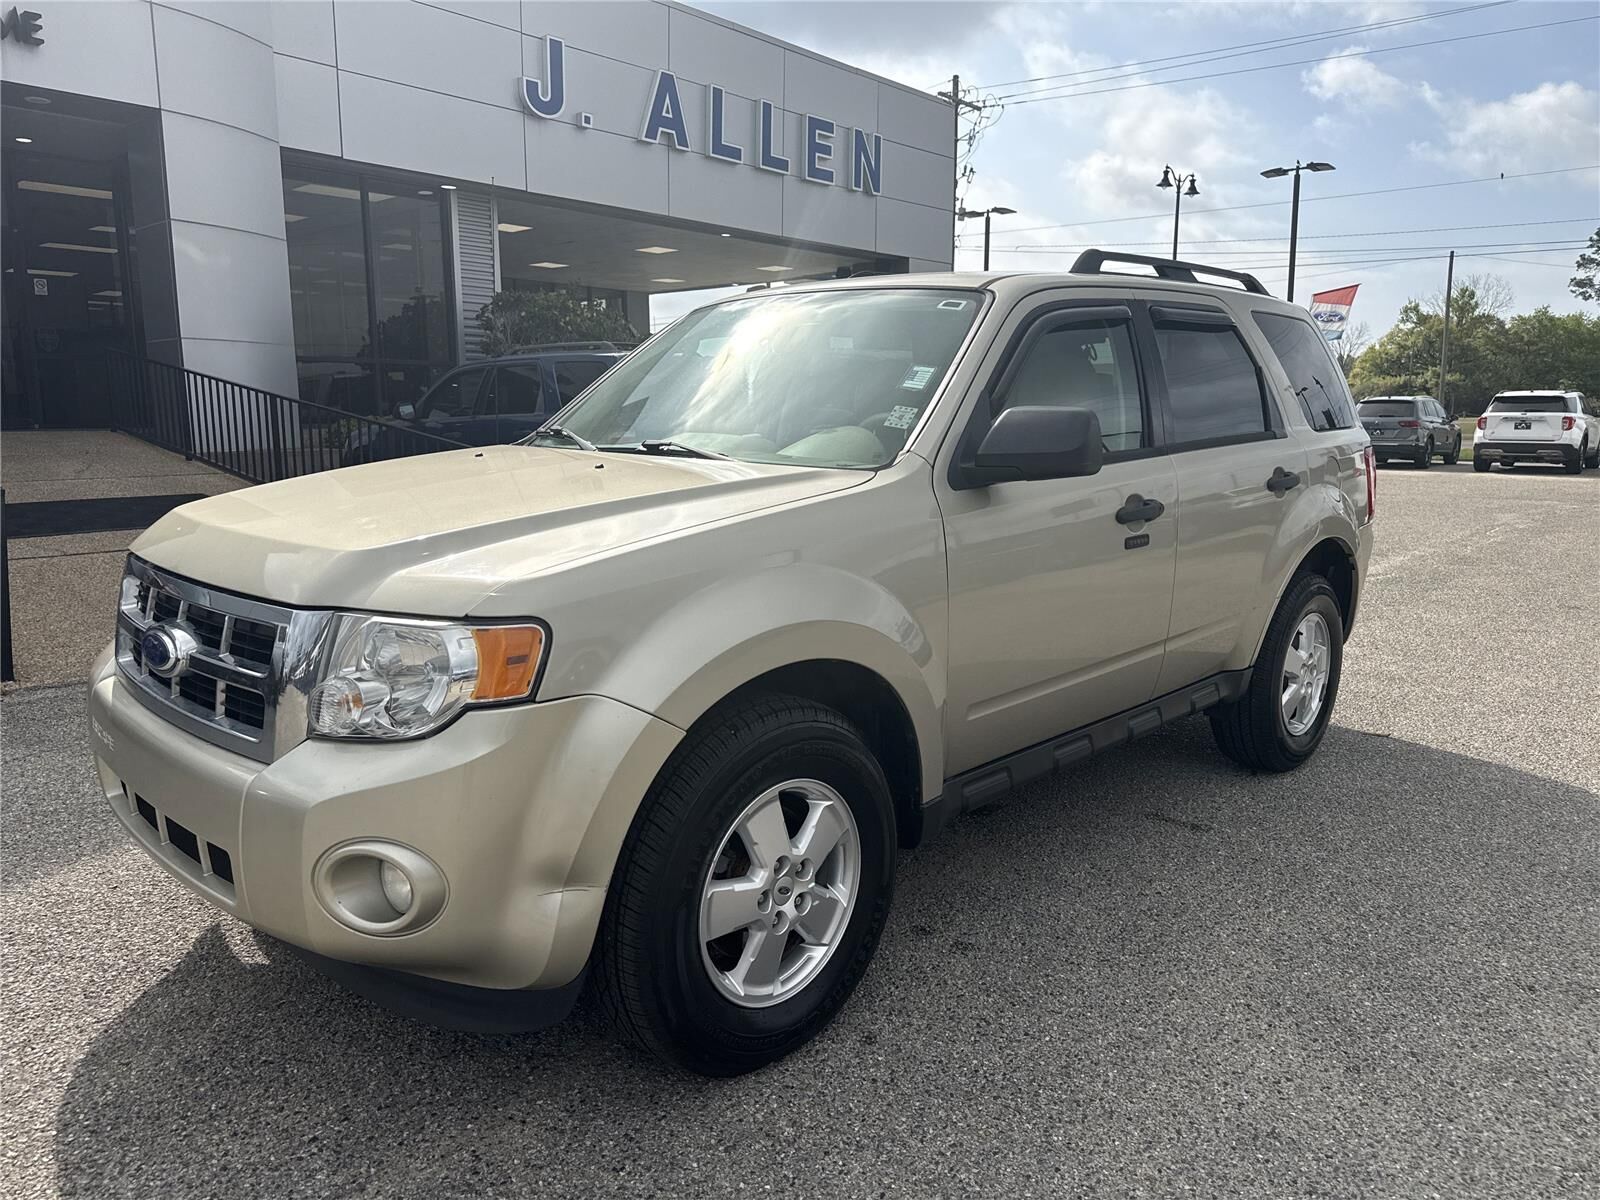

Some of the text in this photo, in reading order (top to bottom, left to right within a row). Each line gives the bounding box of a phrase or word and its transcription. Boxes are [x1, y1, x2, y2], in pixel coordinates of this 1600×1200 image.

[521, 34, 883, 196] J. ALLEN
[1317, 311, 1342, 321] Ford
